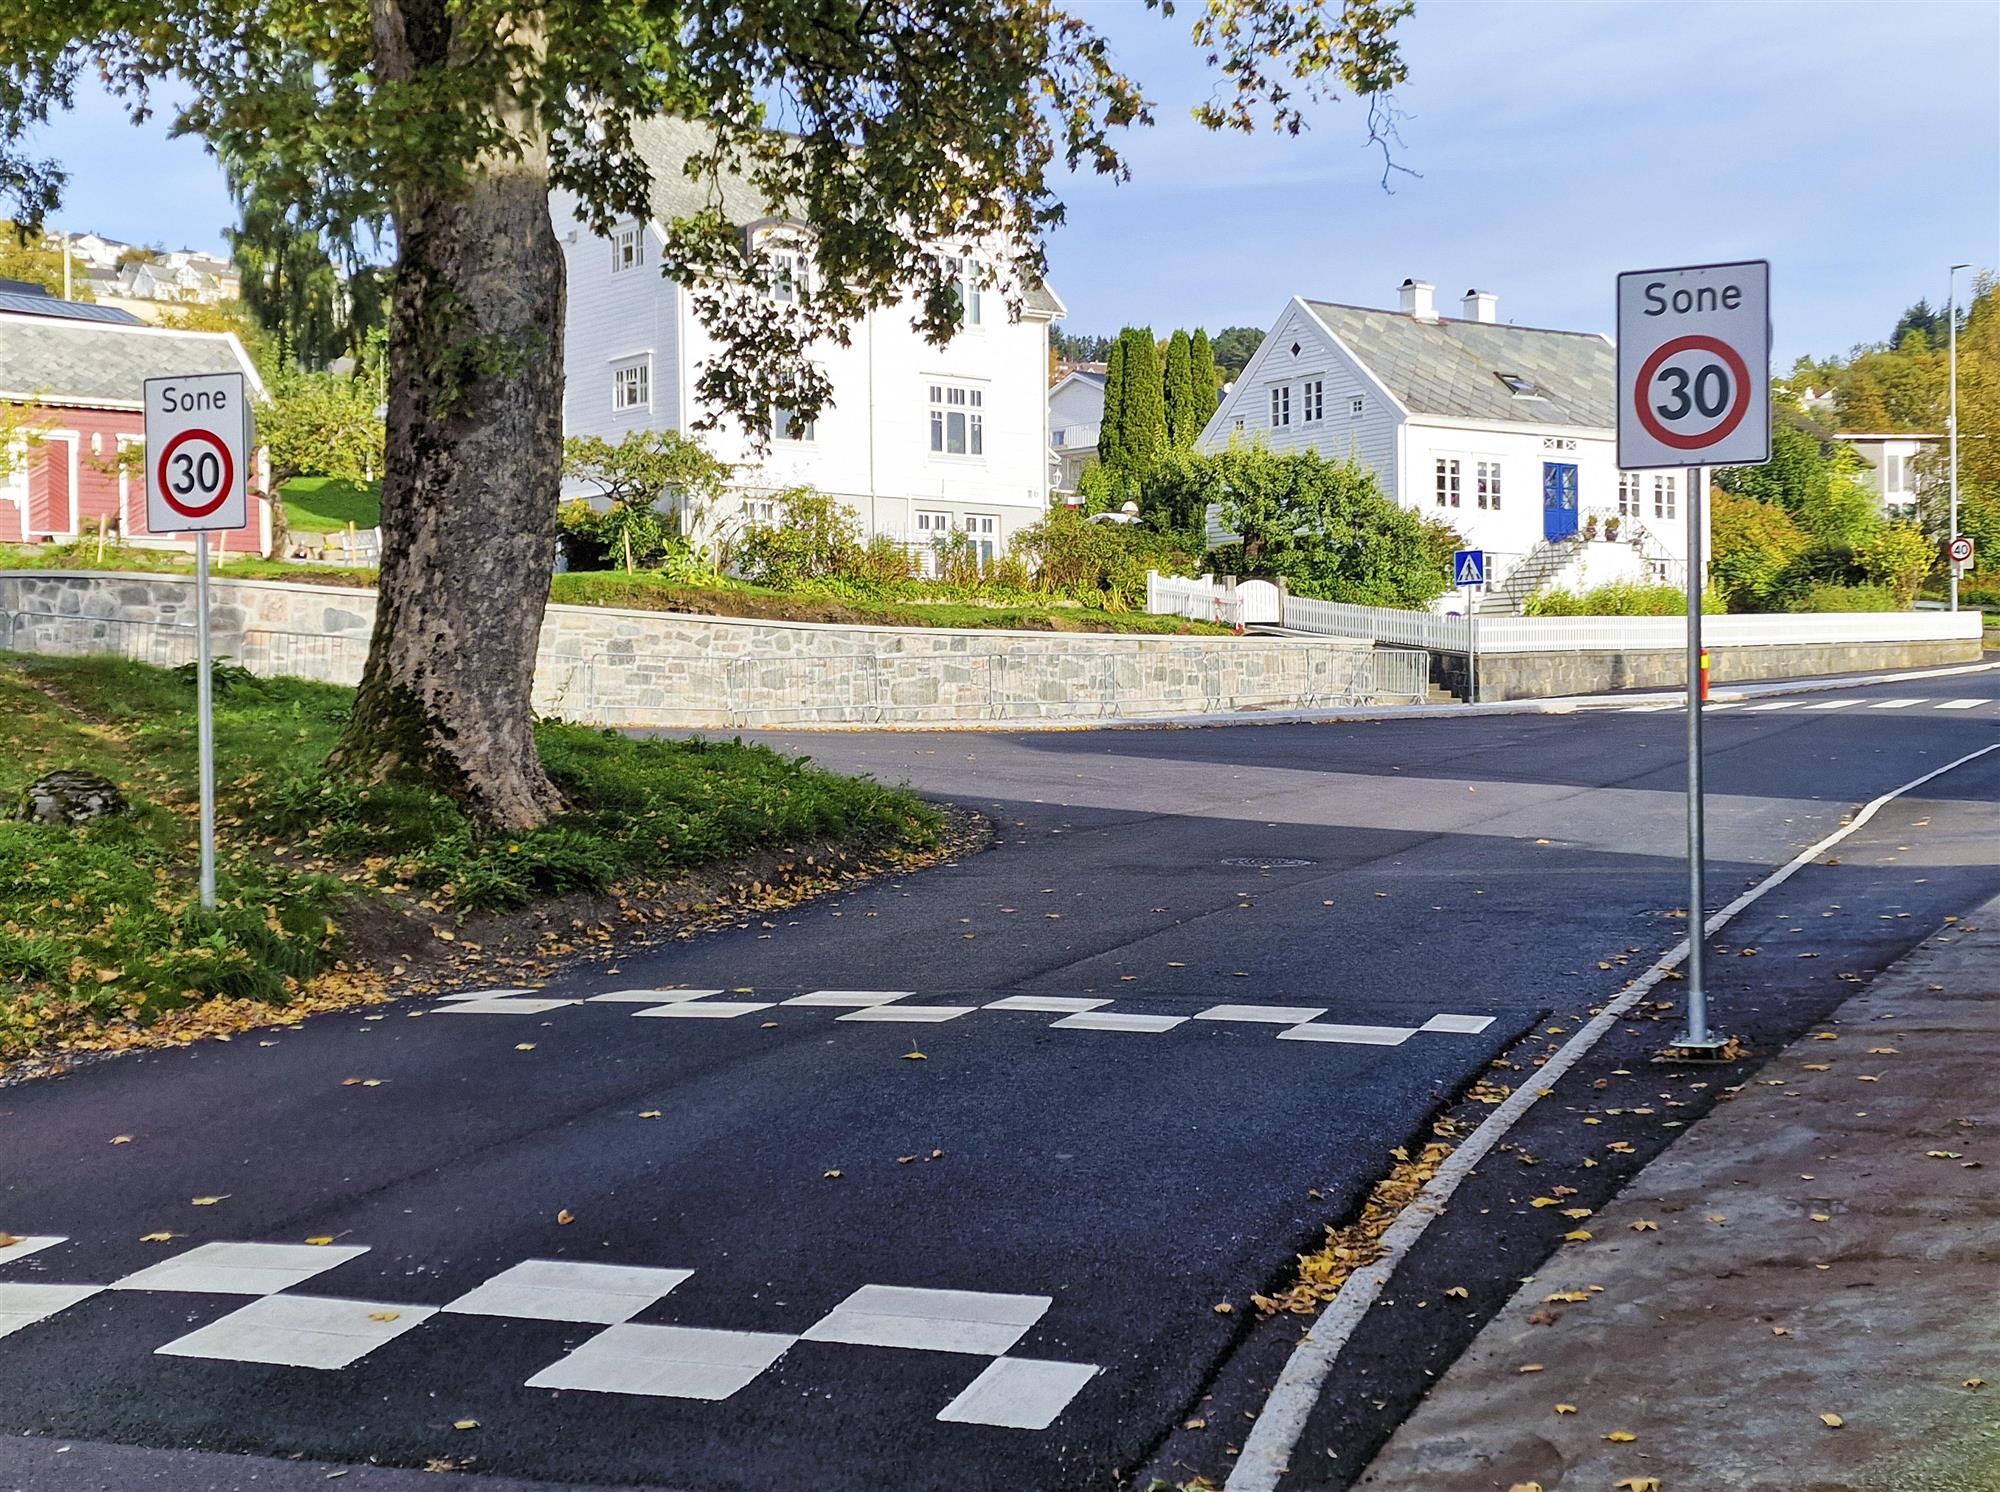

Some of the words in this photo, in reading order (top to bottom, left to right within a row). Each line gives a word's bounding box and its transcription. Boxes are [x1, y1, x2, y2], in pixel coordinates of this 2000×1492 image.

[1643, 282, 1742, 316] Sone
[162, 387, 226, 413] Sone
[1656, 364, 1730, 421] 30
[172, 452, 219, 494] 30
[1954, 544, 1968, 555] 40
